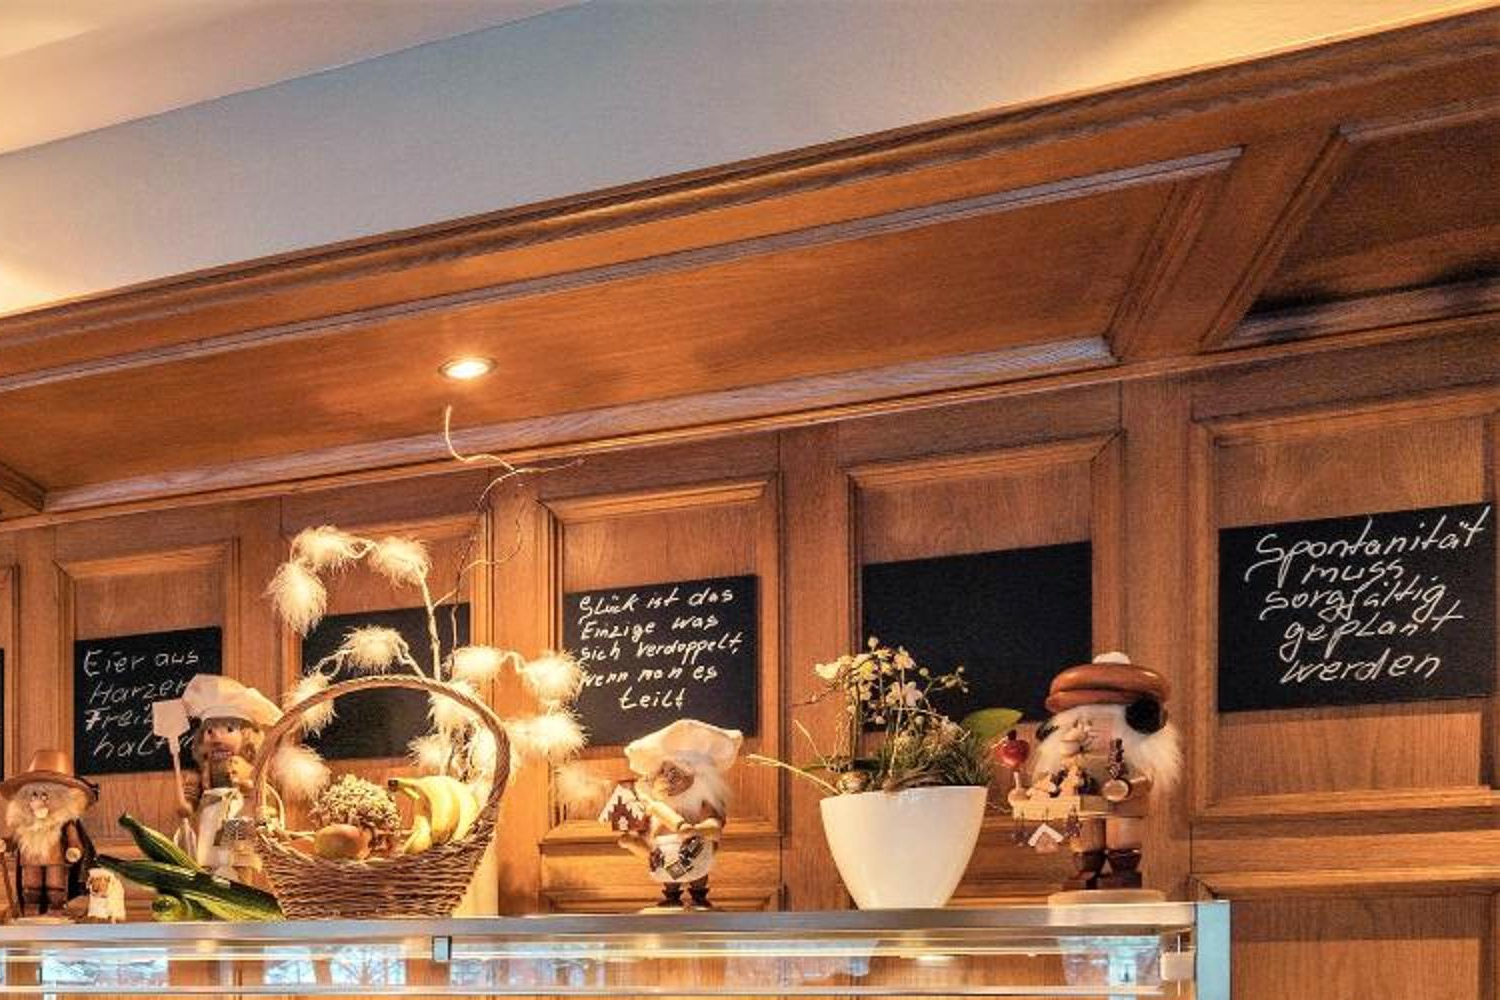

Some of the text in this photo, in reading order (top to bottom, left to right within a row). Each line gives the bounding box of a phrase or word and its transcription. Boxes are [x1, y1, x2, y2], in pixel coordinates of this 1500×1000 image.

[1301, 559, 1405, 586] muss
[578, 586, 734, 625] Glück ist das
[581, 614, 719, 643] Einzige was
[1279, 600, 1465, 662] geplant
[84, 649, 199, 678] Eier aus
[578, 640, 621, 664] sich
[1280, 648, 1441, 683] werden
[637, 666, 683, 682] man
[693, 665, 718, 683] es
